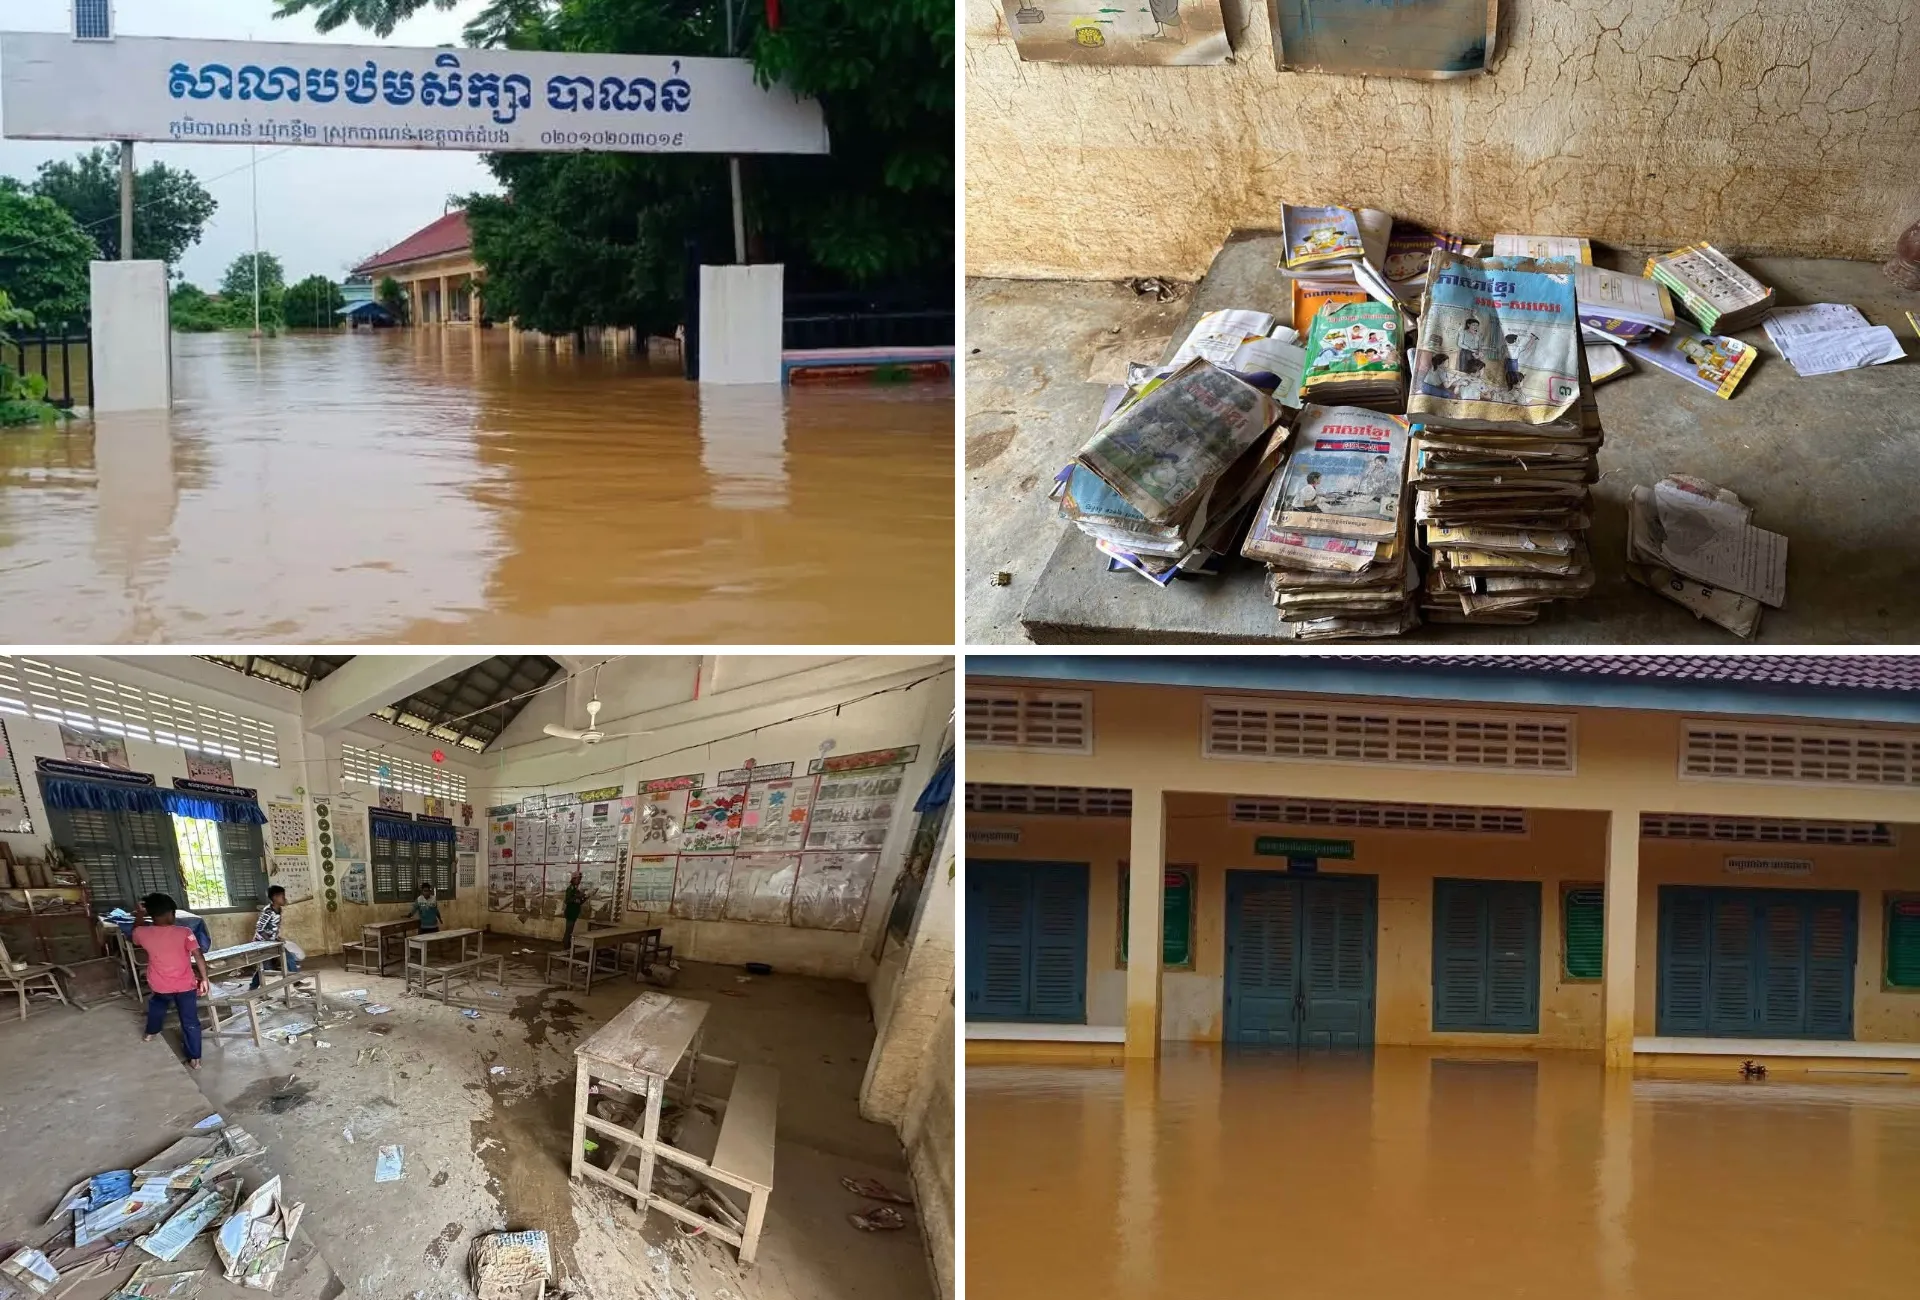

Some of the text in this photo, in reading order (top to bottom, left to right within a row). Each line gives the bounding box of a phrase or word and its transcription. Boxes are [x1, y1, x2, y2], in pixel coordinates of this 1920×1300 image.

[169, 53, 691, 124] សាលាបឋមសិក្សា បាណន់
[541, 130, 684, 146] ០២០១០២០៣០១៩
[1437, 273, 1516, 298] ភាសាខ្មែរ
[1321, 424, 1391, 441] ភាសាខ្មែរ
